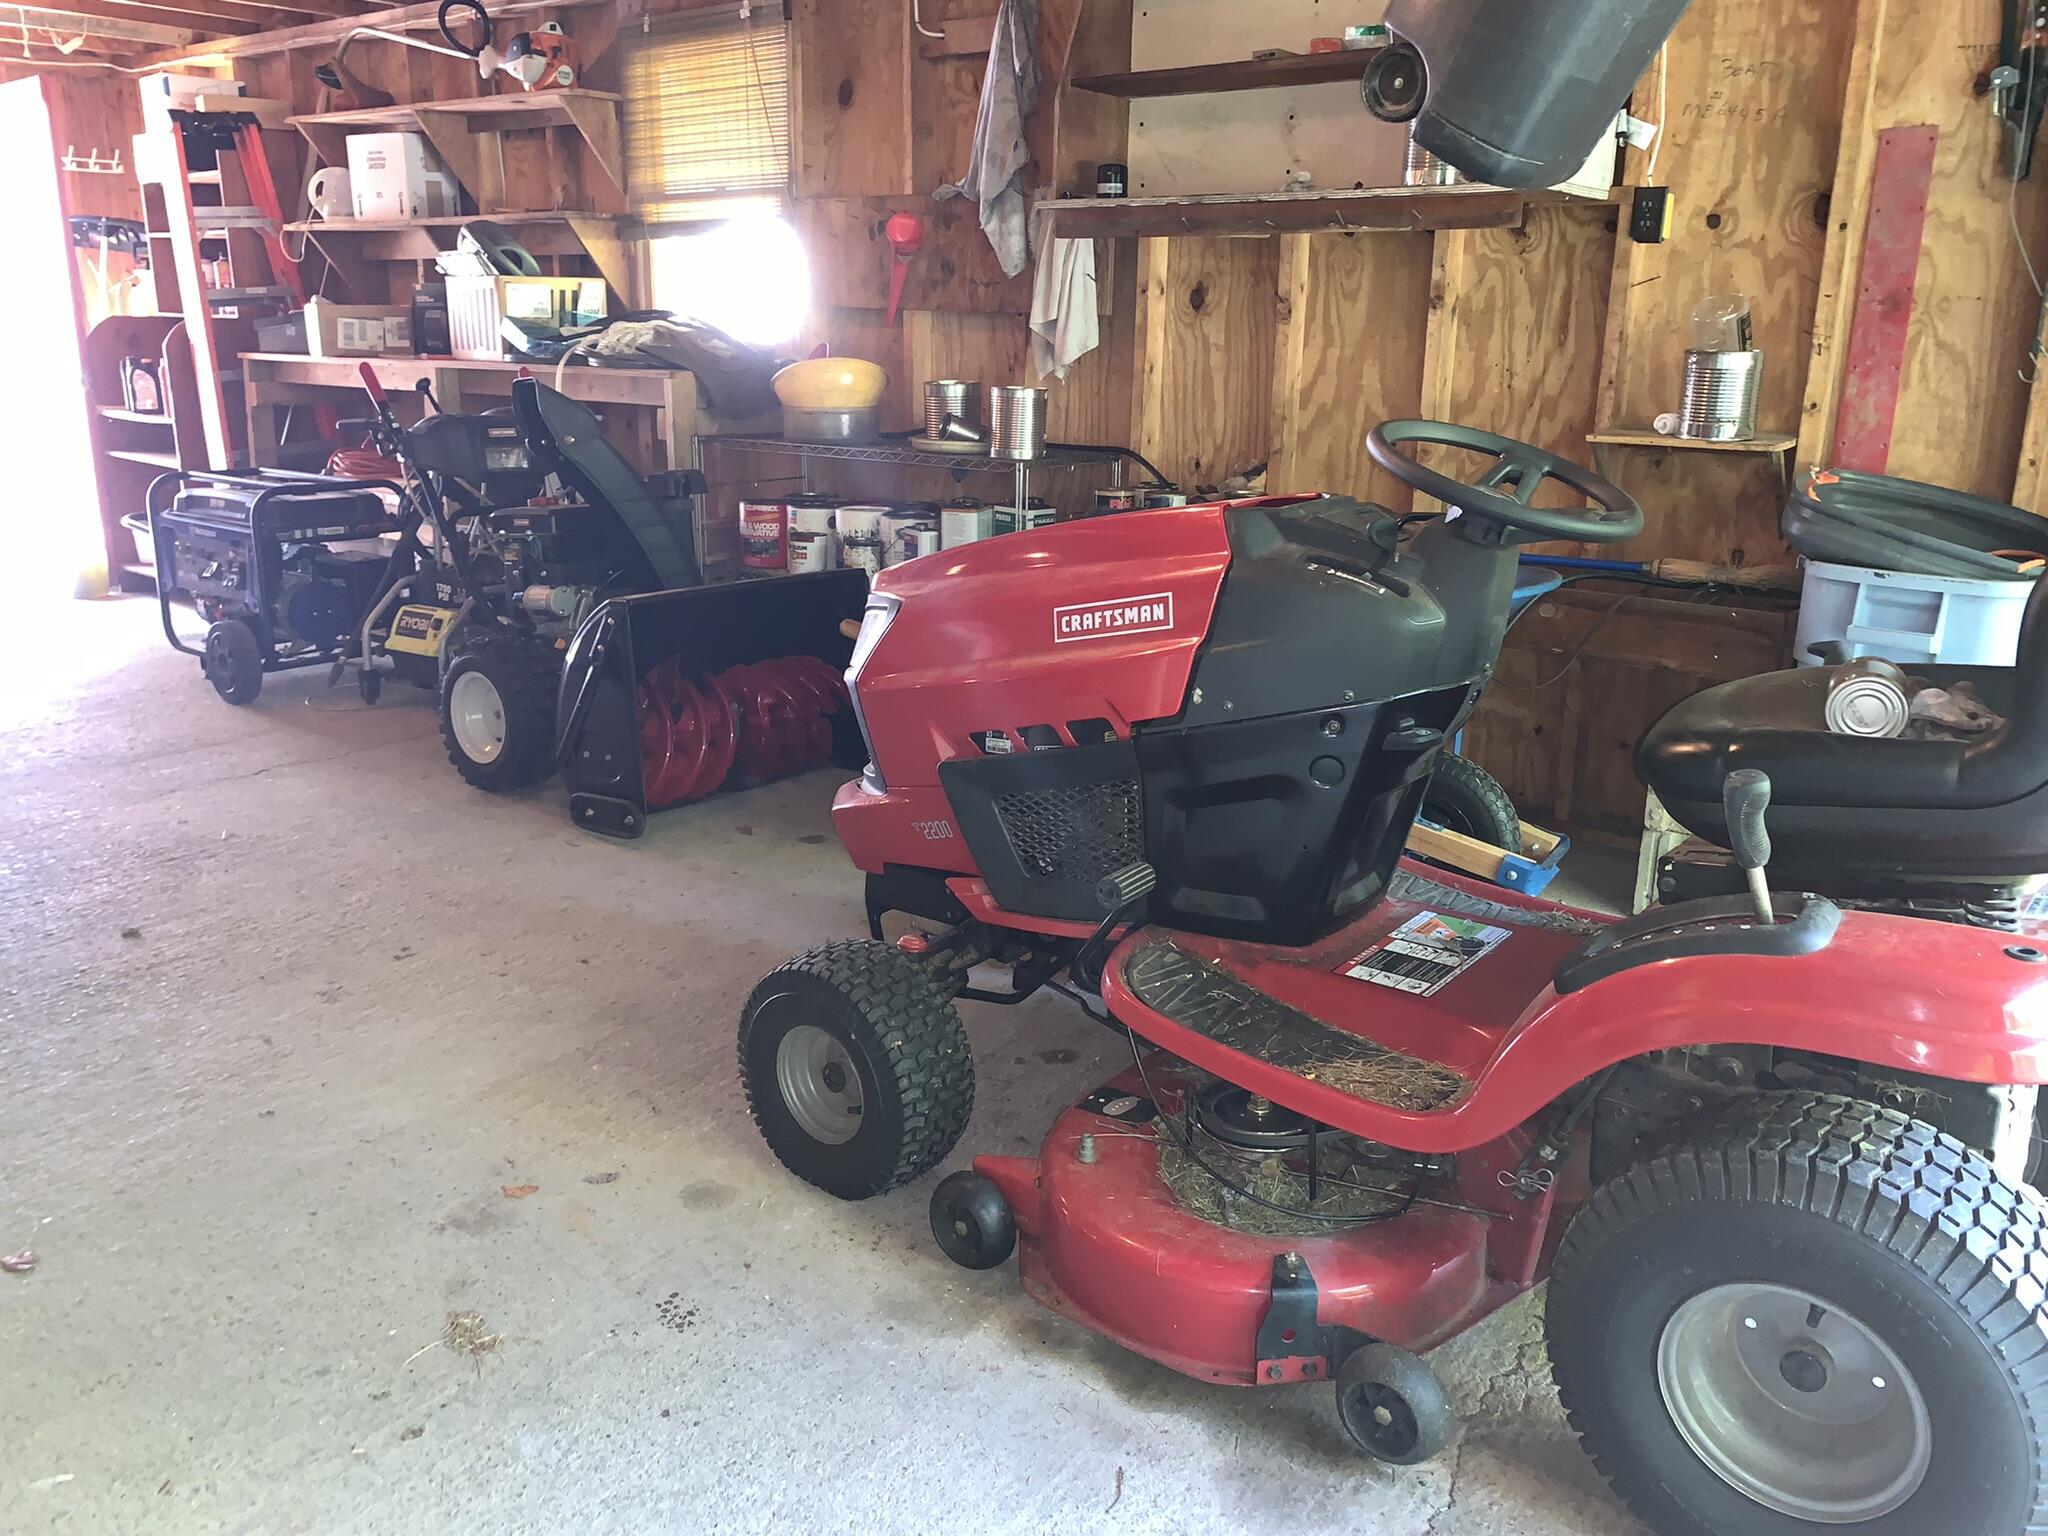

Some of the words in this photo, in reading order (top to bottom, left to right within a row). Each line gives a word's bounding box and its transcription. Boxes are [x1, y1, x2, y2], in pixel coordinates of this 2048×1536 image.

[754, 522, 779, 530] WOOD
[400, 615, 429, 630] RYOBI
[1061, 603, 1165, 633] CRAFTSMAN
